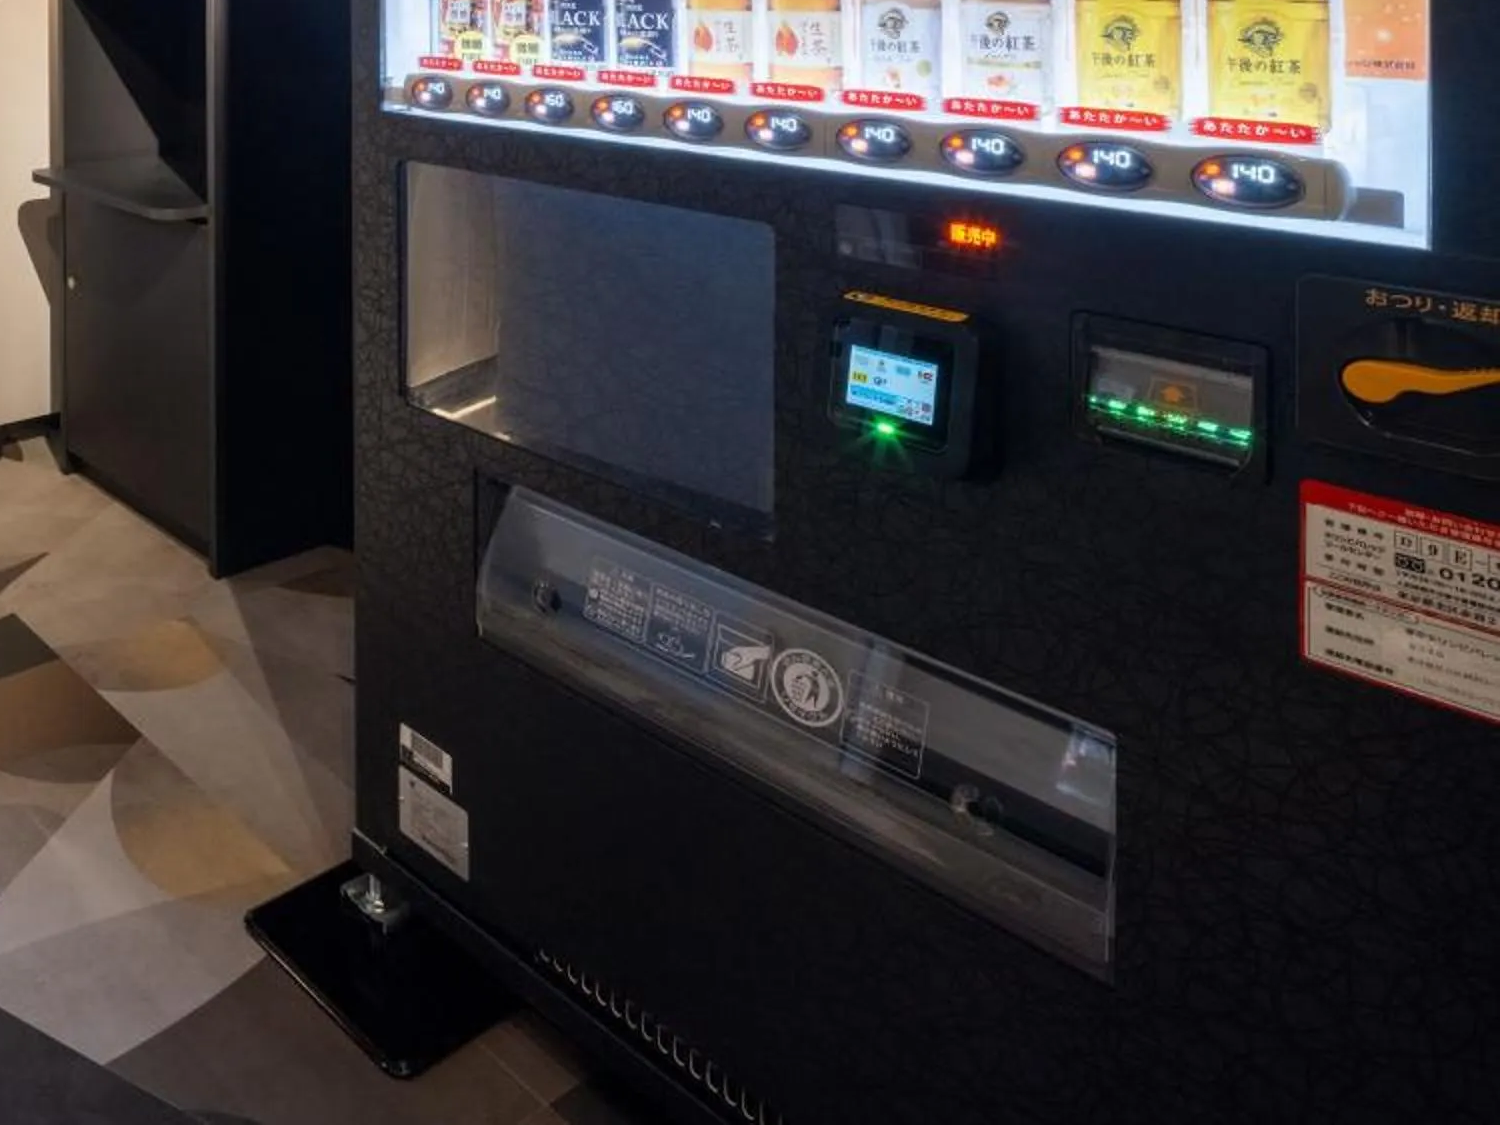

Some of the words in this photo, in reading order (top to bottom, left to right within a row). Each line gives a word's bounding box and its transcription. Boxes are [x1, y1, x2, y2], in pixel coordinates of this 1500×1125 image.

[1091, 51, 1157, 69] 午後の紅茶
[1227, 57, 1302, 75] 午後の紅茶
[847, 92, 920, 108] あたたか〜い
[950, 100, 1031, 117] あたたか〜い
[686, 109, 712, 124] 140
[770, 118, 798, 133] 140
[1068, 108, 1158, 127] あたたか〜い
[863, 126, 896, 143] 140
[1202, 120, 1308, 140] あたたか〜い
[970, 137, 1006, 156] 140
[1092, 149, 1132, 168] 140
[1231, 164, 1276, 184] 140
[950, 222, 998, 246] 販売中
[1364, 286, 1500, 325] おつり・返却
